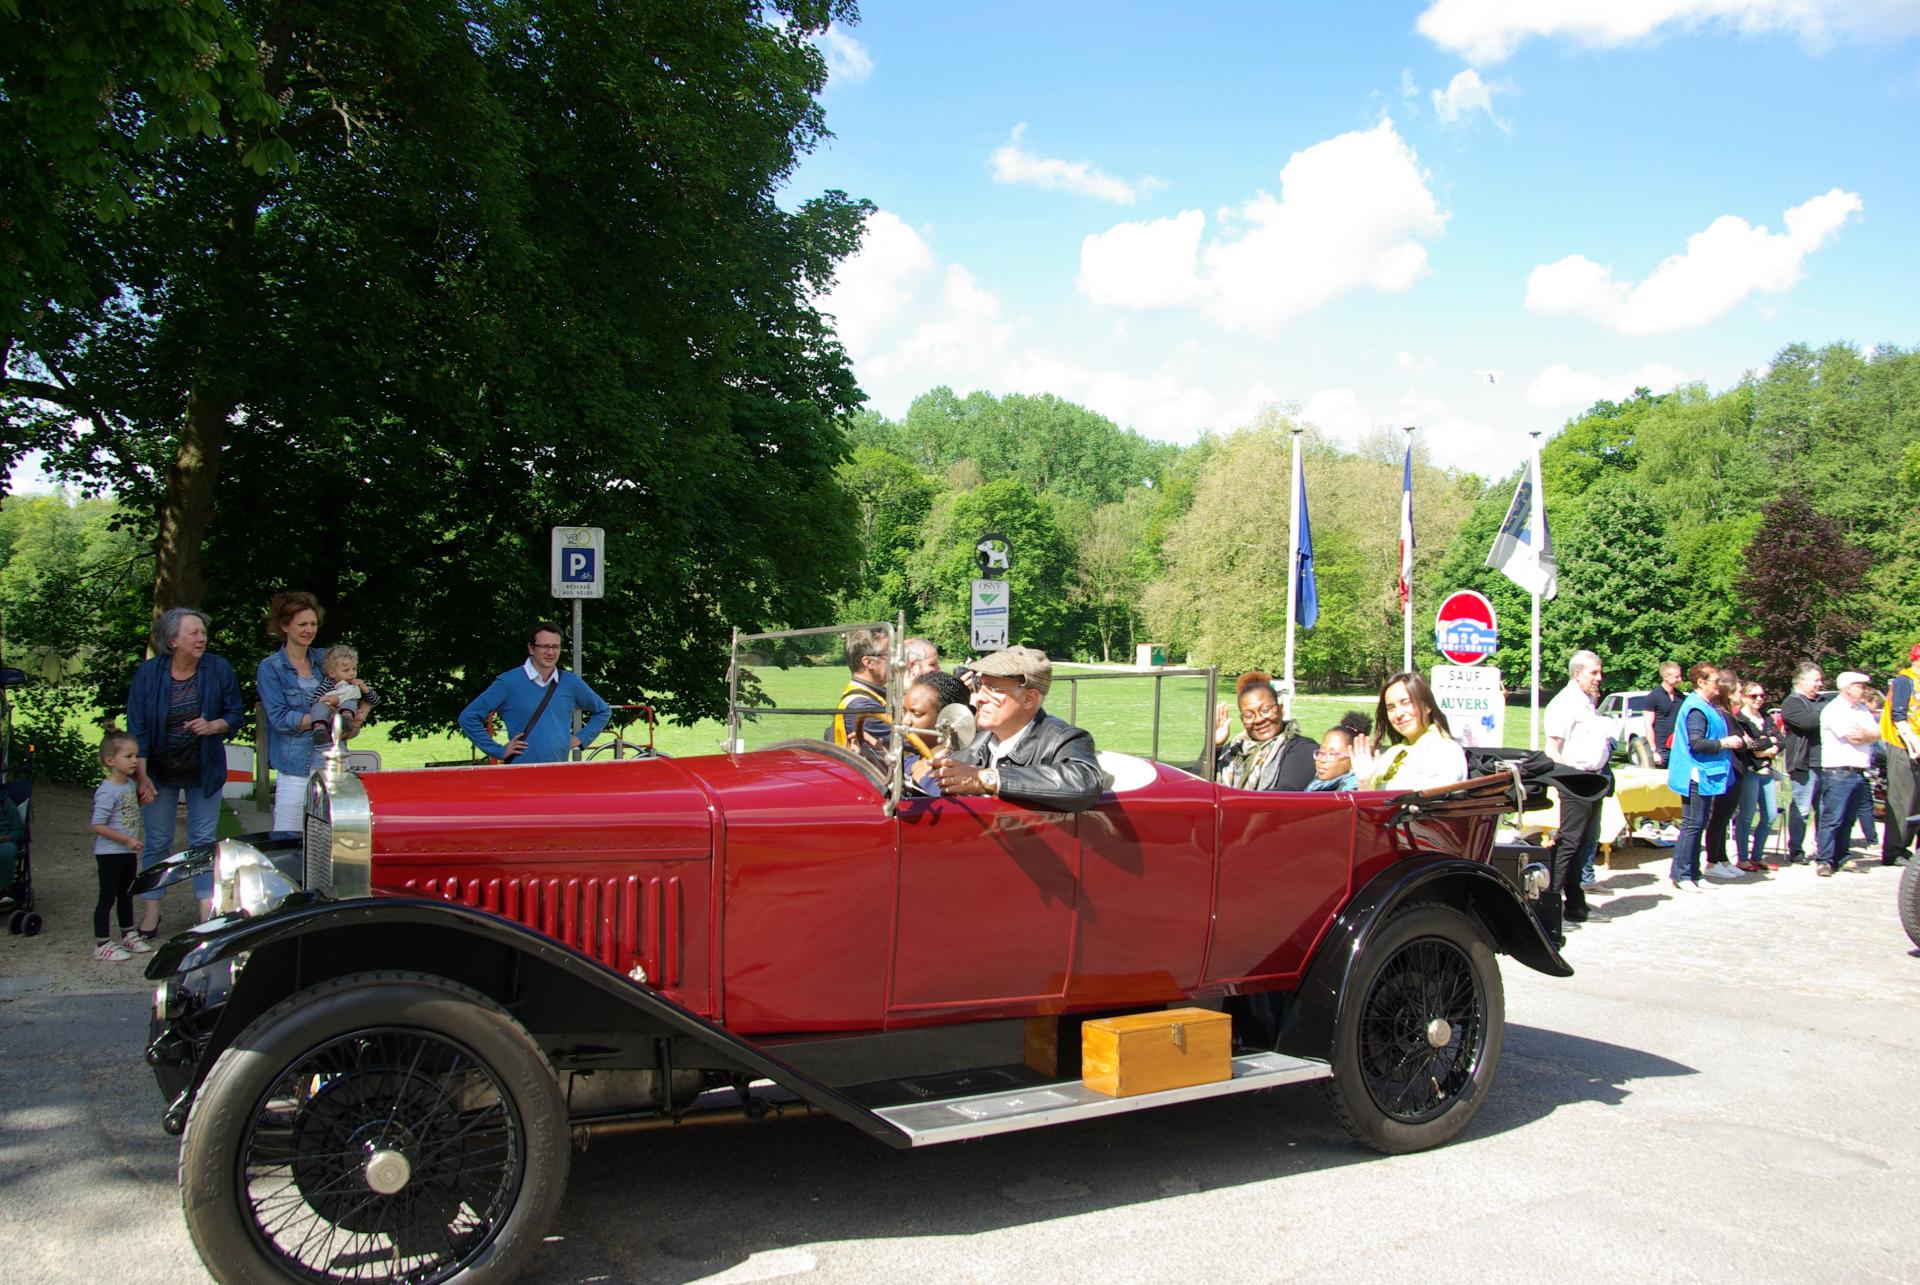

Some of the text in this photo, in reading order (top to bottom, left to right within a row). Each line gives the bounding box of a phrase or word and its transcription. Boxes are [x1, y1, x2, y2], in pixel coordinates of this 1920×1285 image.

[570, 553, 587, 577] P
[1449, 670, 1480, 681] SAUF
[1440, 697, 1489, 709] AUVERS
